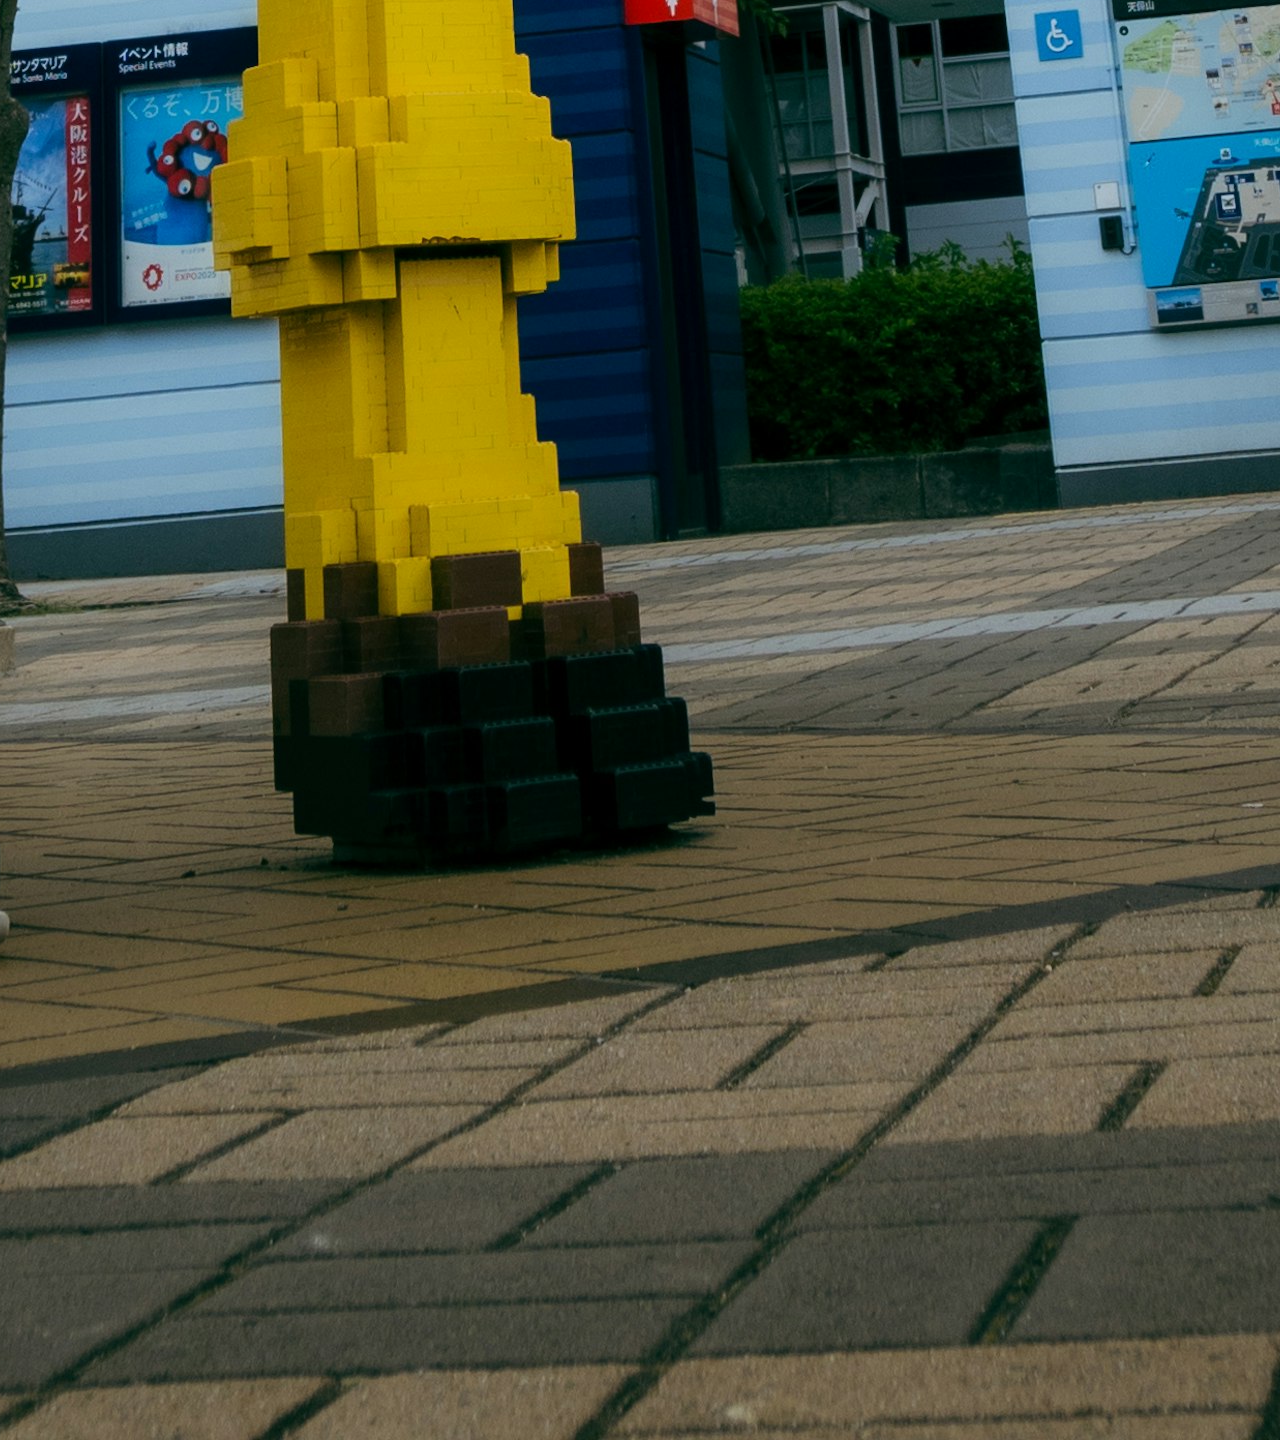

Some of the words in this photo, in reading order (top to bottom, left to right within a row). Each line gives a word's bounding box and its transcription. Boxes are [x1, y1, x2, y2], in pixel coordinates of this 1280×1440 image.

[118, 41, 189, 62] イベント情報
[118, 61, 148, 75] Special
[149, 59, 177, 71] Events
[69, 101, 90, 245] 大阪港クルーズ
